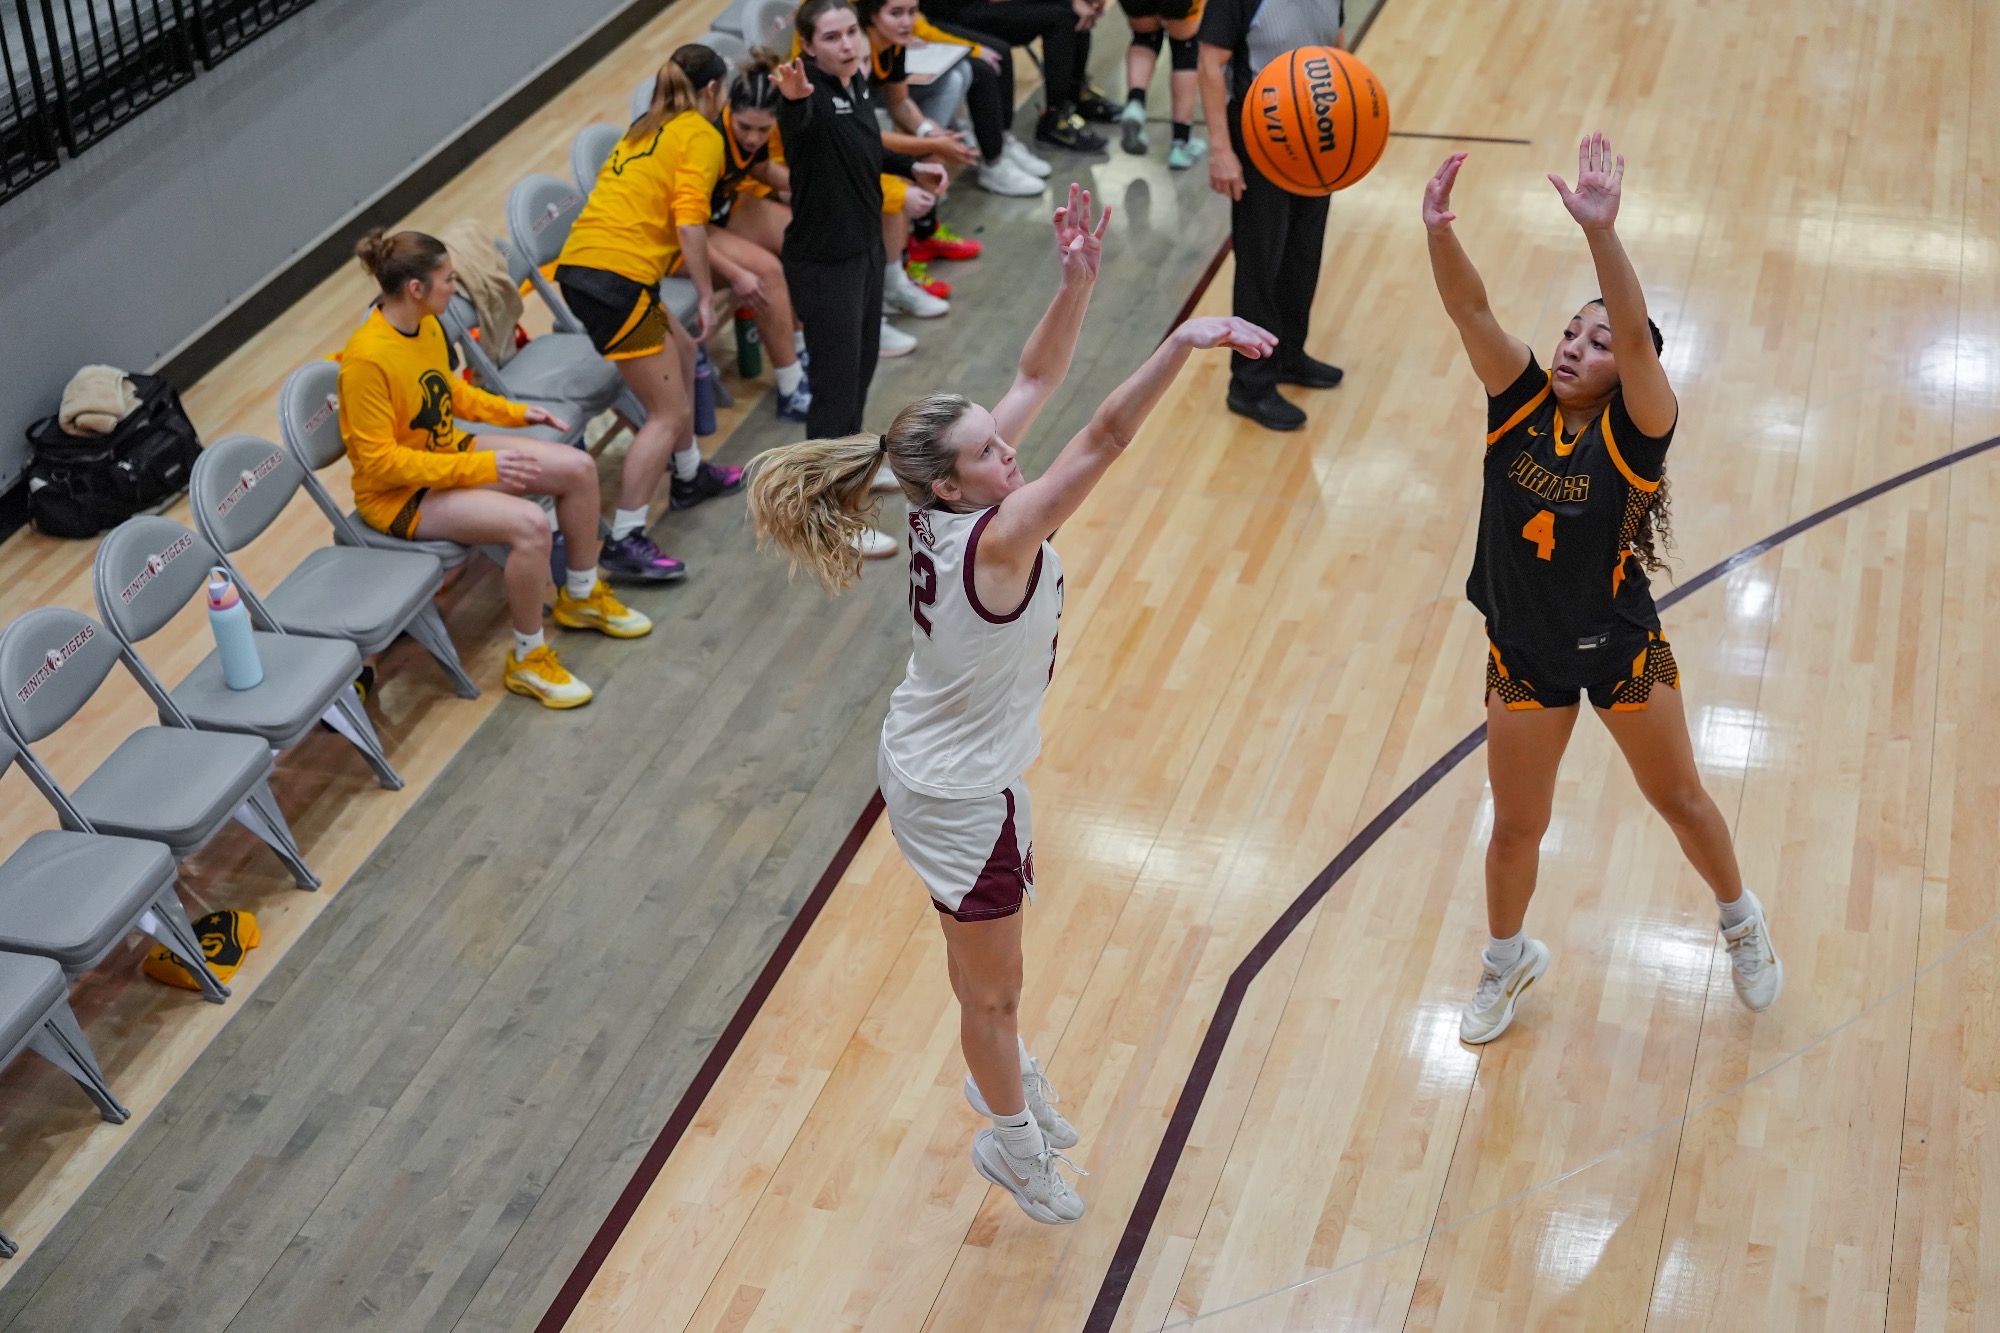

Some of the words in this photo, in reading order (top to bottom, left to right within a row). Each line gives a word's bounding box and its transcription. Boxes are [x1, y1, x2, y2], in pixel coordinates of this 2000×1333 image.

[1304, 57, 1337, 153] Wilson
[121, 567, 152, 604] TRINITY
[160, 533, 193, 566] TIGERS
[1522, 510, 1555, 561] 4
[16, 662, 51, 703] TRINITY
[59, 624, 95, 660] TIGERS
